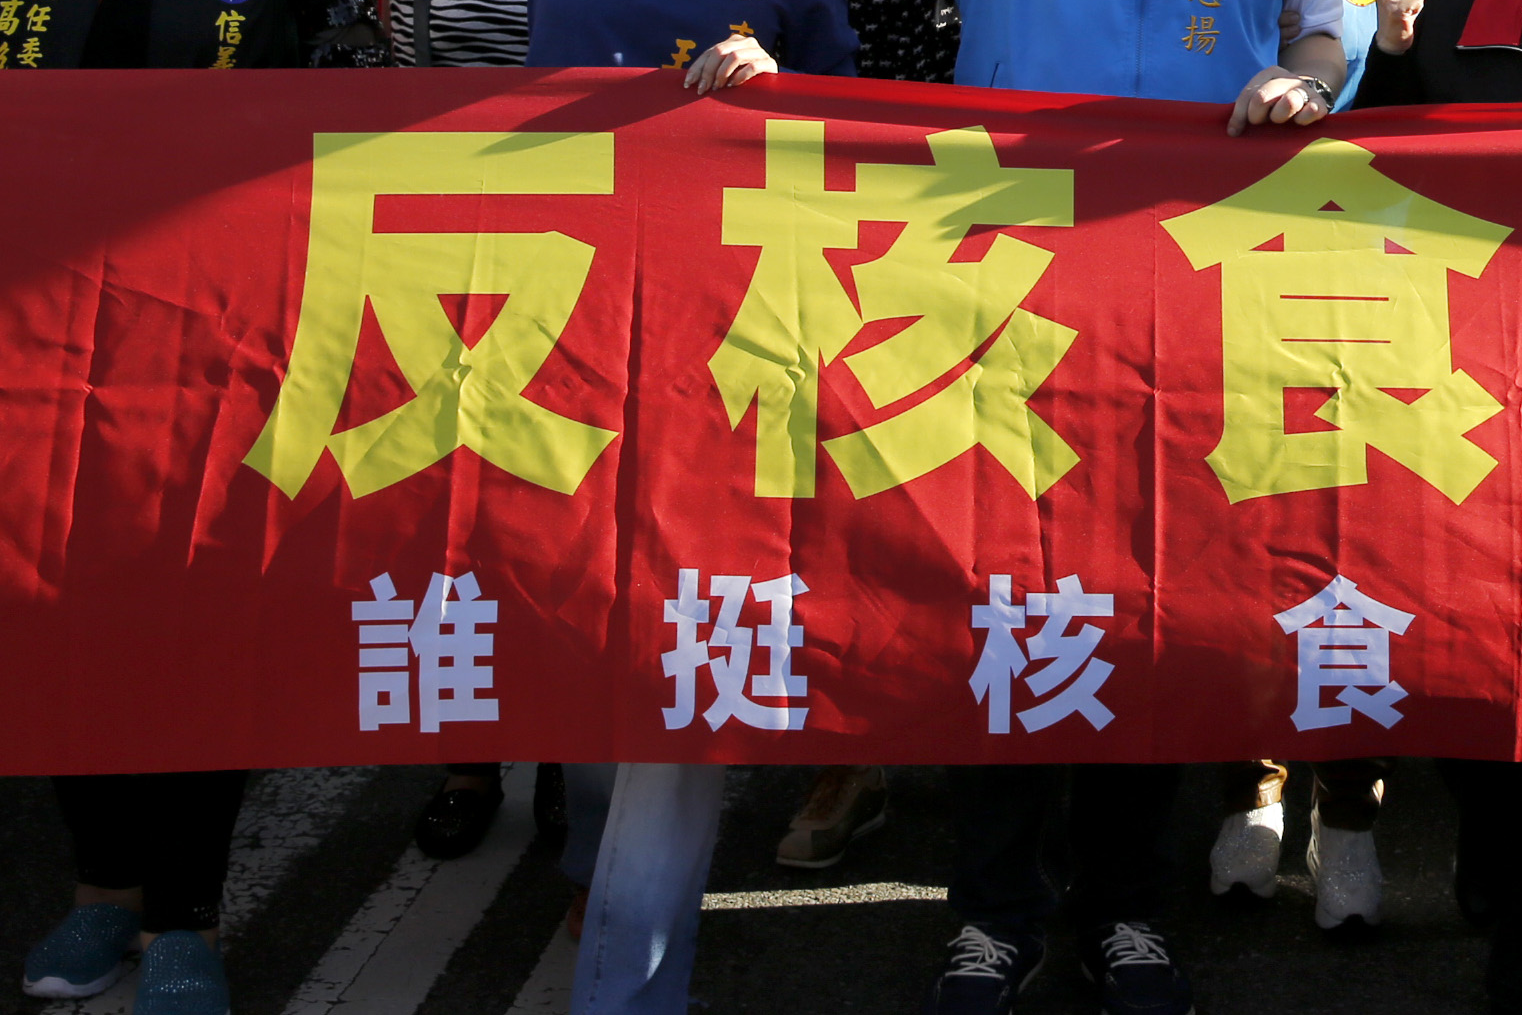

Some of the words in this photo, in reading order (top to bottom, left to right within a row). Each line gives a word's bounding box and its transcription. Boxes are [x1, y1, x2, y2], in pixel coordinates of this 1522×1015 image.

[242, 119, 1515, 506] 反核食
[350, 568, 1416, 735] 誰挺核食
